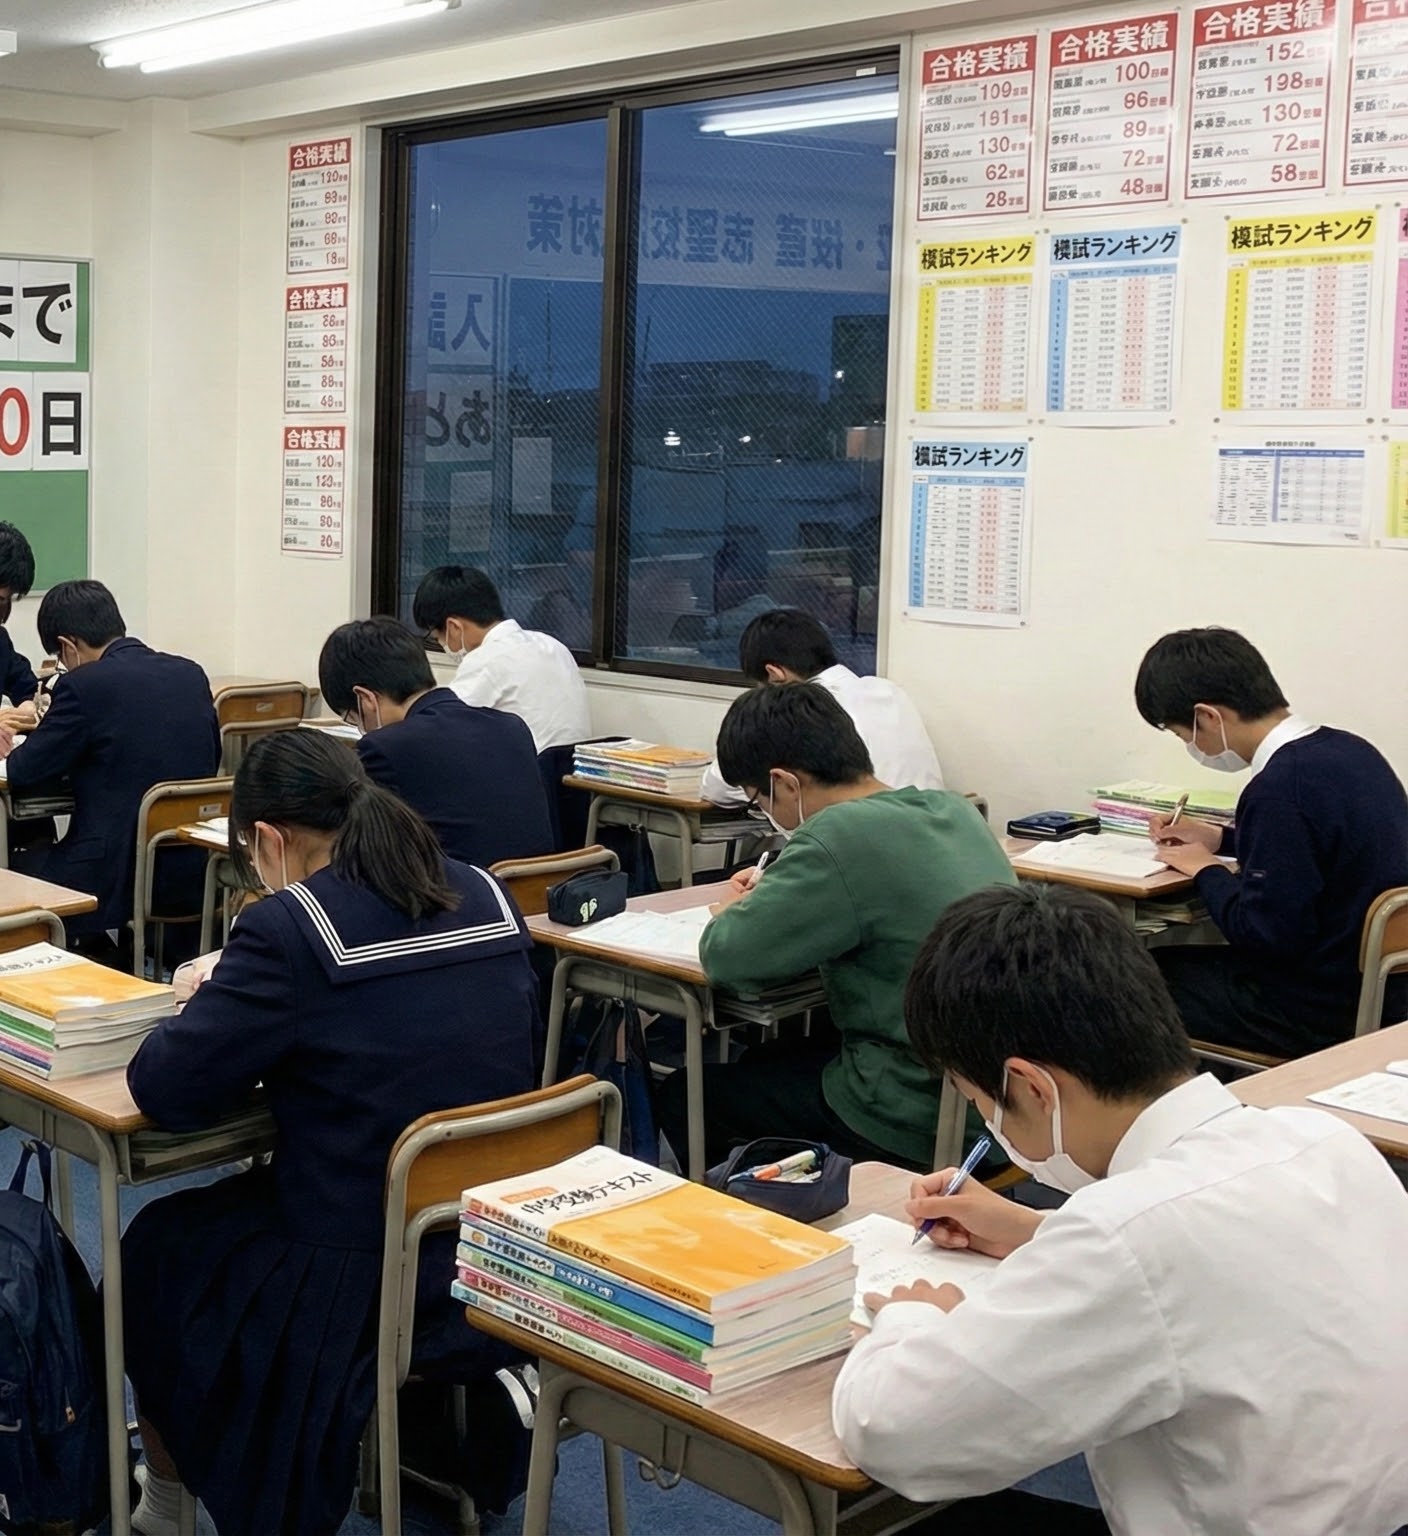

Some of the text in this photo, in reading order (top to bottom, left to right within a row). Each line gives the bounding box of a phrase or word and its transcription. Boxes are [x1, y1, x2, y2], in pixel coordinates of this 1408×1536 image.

[1203, 0, 1325, 41] 合格実績
[1058, 20, 1169, 63] 合格実績
[1266, 41, 1305, 62] 152
[929, 41, 1029, 81] 合格実績
[1115, 61, 1150, 83] 100
[1264, 71, 1303, 93] 198
[981, 81, 1012, 101] 109
[1262, 102, 1301, 123] 130
[1123, 120, 1147, 138] 89
[978, 136, 1010, 155] 130
[1273, 133, 1299, 152] 72
[1122, 150, 1145, 167] 72
[985, 164, 1007, 181] 62
[1271, 163, 1297, 183] 58
[1120, 178, 1144, 196] 48
[985, 190, 1007, 208] 28
[1231, 216, 1374, 250] 模試ランキング
